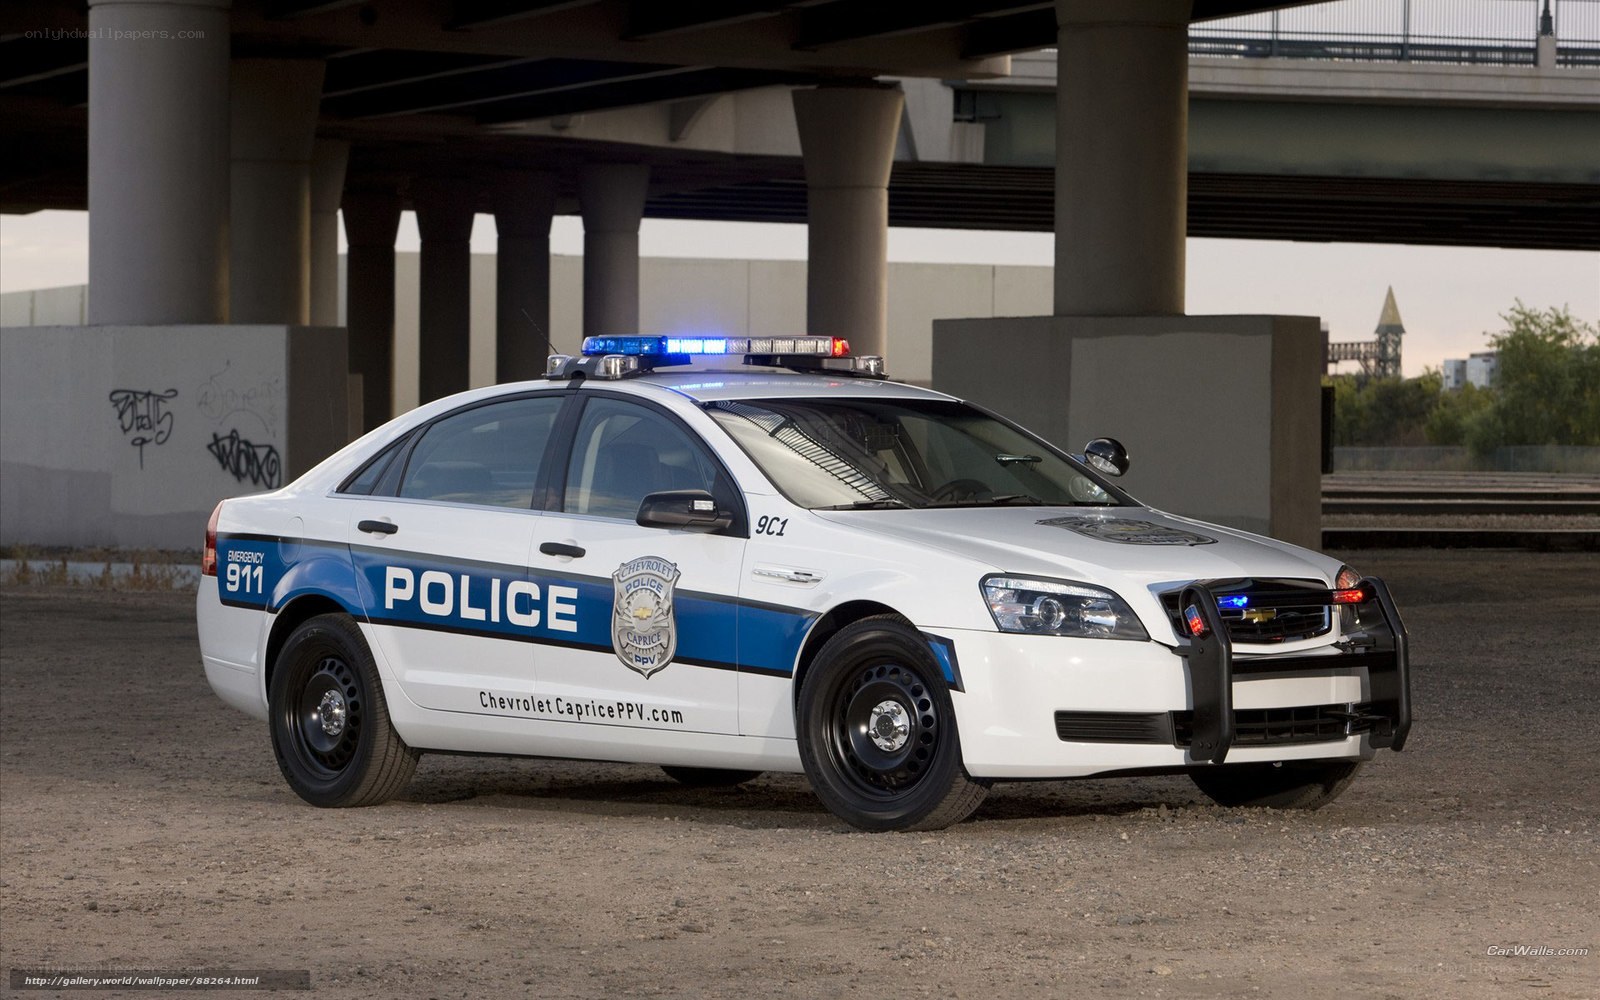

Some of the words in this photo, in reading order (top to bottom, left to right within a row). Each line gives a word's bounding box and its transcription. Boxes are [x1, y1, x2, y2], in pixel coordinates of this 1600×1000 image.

[755, 515, 789, 536] 9C1
[227, 550, 264, 564] EMERGENCY
[621, 560, 672, 578] CHEVROLET
[226, 563, 264, 594] 911
[625, 579, 663, 593] POLICE
[384, 565, 578, 633] POLICE
[626, 631, 662, 646] CAPRICE
[634, 654, 656, 665] PPV
